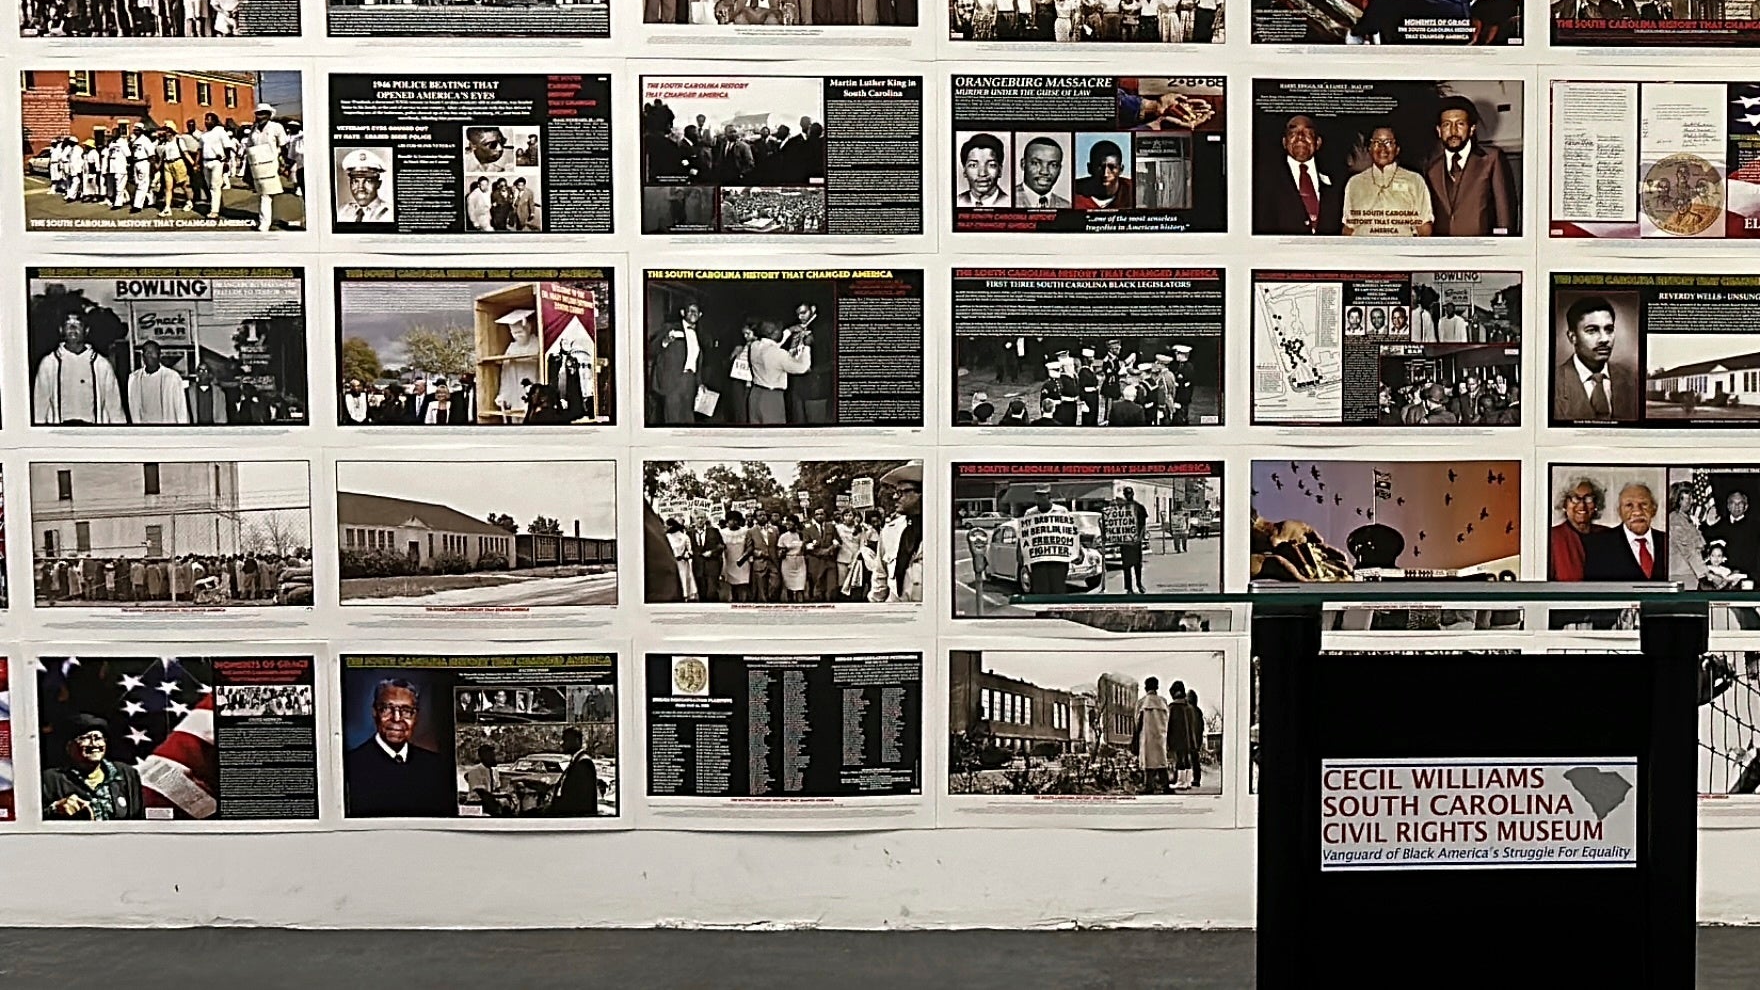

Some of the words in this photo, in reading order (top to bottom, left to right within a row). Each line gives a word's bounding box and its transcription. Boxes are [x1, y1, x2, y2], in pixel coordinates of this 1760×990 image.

[372, 81, 391, 89] 1946
[393, 81, 427, 89] POLICE
[429, 81, 471, 89] BEATING
[472, 81, 499, 89] THAT
[829, 79, 858, 87] Martin
[859, 79, 886, 87] Luther
[886, 79, 907, 89] King
[907, 79, 917, 87] in
[955, 77, 1043, 87] ORANGEBURG
[1045, 78, 1113, 88] MASSACRE
[376, 91, 415, 99] OPENED
[416, 91, 469, 99] AMERICA'S
[470, 91, 495, 99] EYES
[843, 89, 867, 97] South
[868, 89, 903, 97] Carolina
[1020, 89, 1035, 97] THE
[1037, 89, 1060, 97] GUISE
[1061, 89, 1072, 97] OF
[647, 270, 664, 279] THE
[665, 270, 694, 279] SOUTH
[695, 270, 741, 279] CAROLINA
[743, 270, 780, 279] HISTORY
[782, 270, 804, 279] THAT
[806, 270, 849, 278] CHANGED
[852, 270, 893, 278] AMERICA
[115, 280, 208, 297] BOWLING
[154, 327, 186, 336] BAR
[1021, 518, 1032, 528] MY
[1021, 528, 1029, 538] IN
[1023, 540, 1029, 548] A
[1032, 536, 1074, 546] FREEDOM
[1323, 769, 1402, 791] CECIL
[1411, 767, 1544, 790] WILLIAMS
[1323, 796, 1419, 818] SOUTH
[1430, 794, 1574, 816] CAROLINA
[1323, 822, 1388, 845] CIVIL
[1397, 821, 1488, 844] RIGHTS
[1498, 820, 1604, 842] MUSEUM
[1323, 848, 1384, 863] Vanguard
[1386, 848, 1402, 860] of
[1404, 848, 1435, 859] Black
[1438, 847, 1502, 859] America's
[1504, 847, 1555, 862] Struggle
[1558, 847, 1579, 858] For
[1582, 847, 1631, 861] Equality
